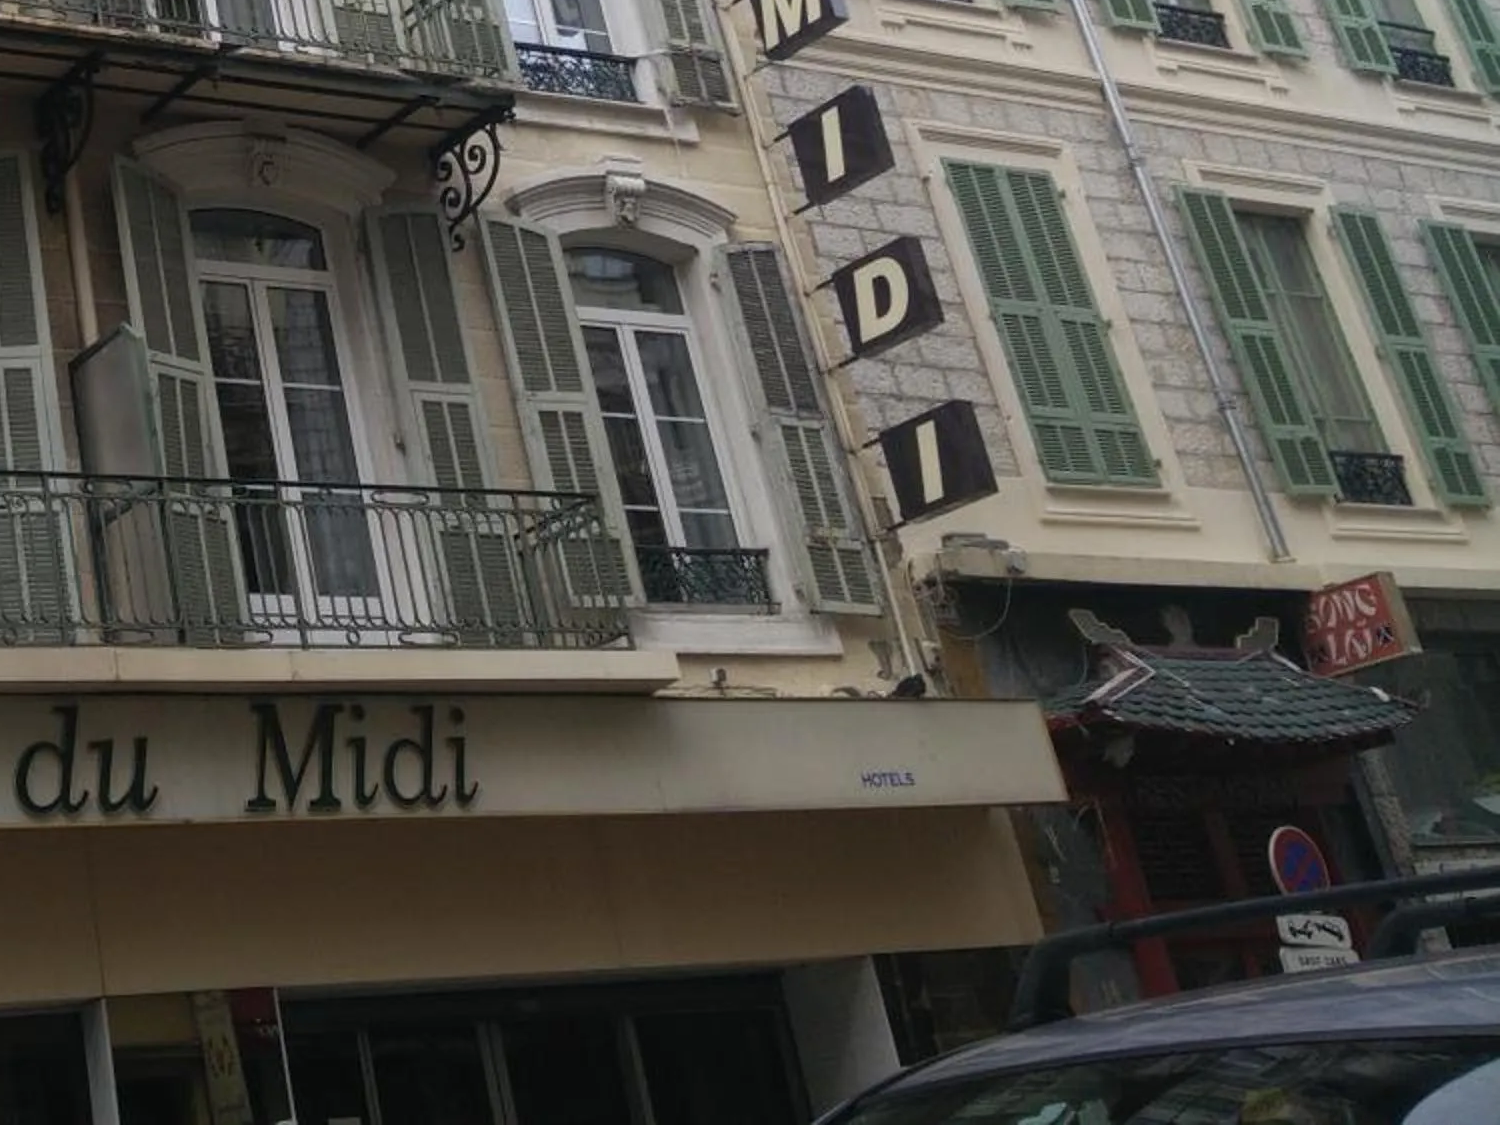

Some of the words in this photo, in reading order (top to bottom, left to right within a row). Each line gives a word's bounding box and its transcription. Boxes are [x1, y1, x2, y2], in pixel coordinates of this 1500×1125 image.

[14, 706, 160, 821] du
[244, 702, 480, 814] Midi
[861, 772, 916, 787] HOTELS
